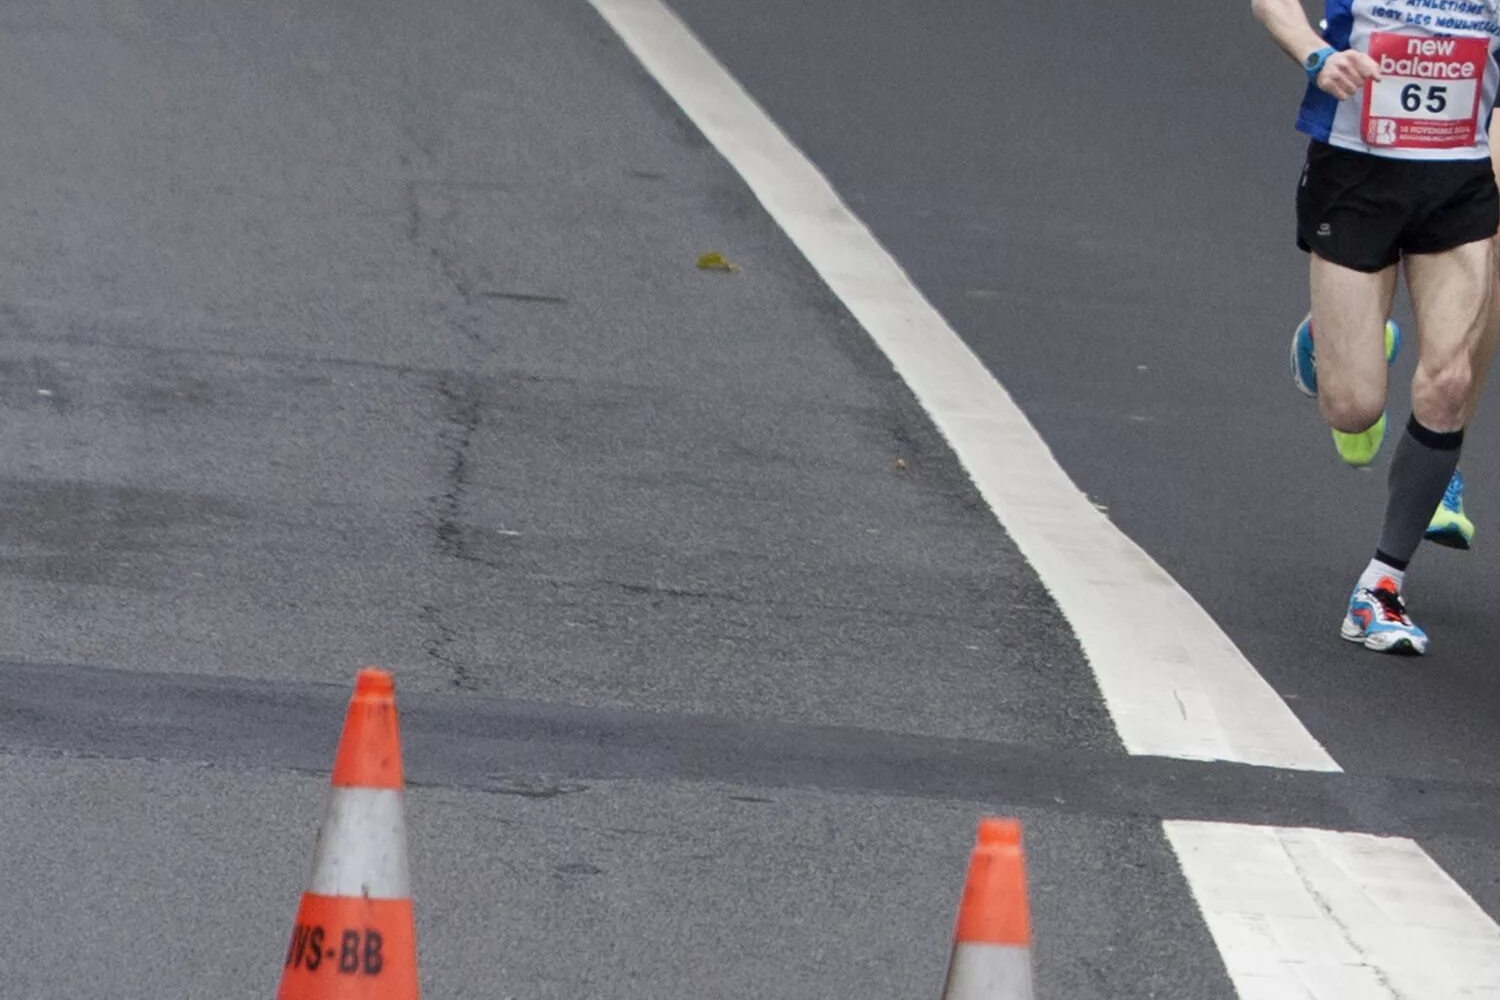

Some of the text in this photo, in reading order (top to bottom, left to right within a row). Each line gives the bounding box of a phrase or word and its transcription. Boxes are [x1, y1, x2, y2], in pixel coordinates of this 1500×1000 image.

[1406, 12, 1431, 25] LES
[1407, 39, 1455, 56] new
[1380, 54, 1475, 78] balance
[1401, 83, 1447, 113] 65
